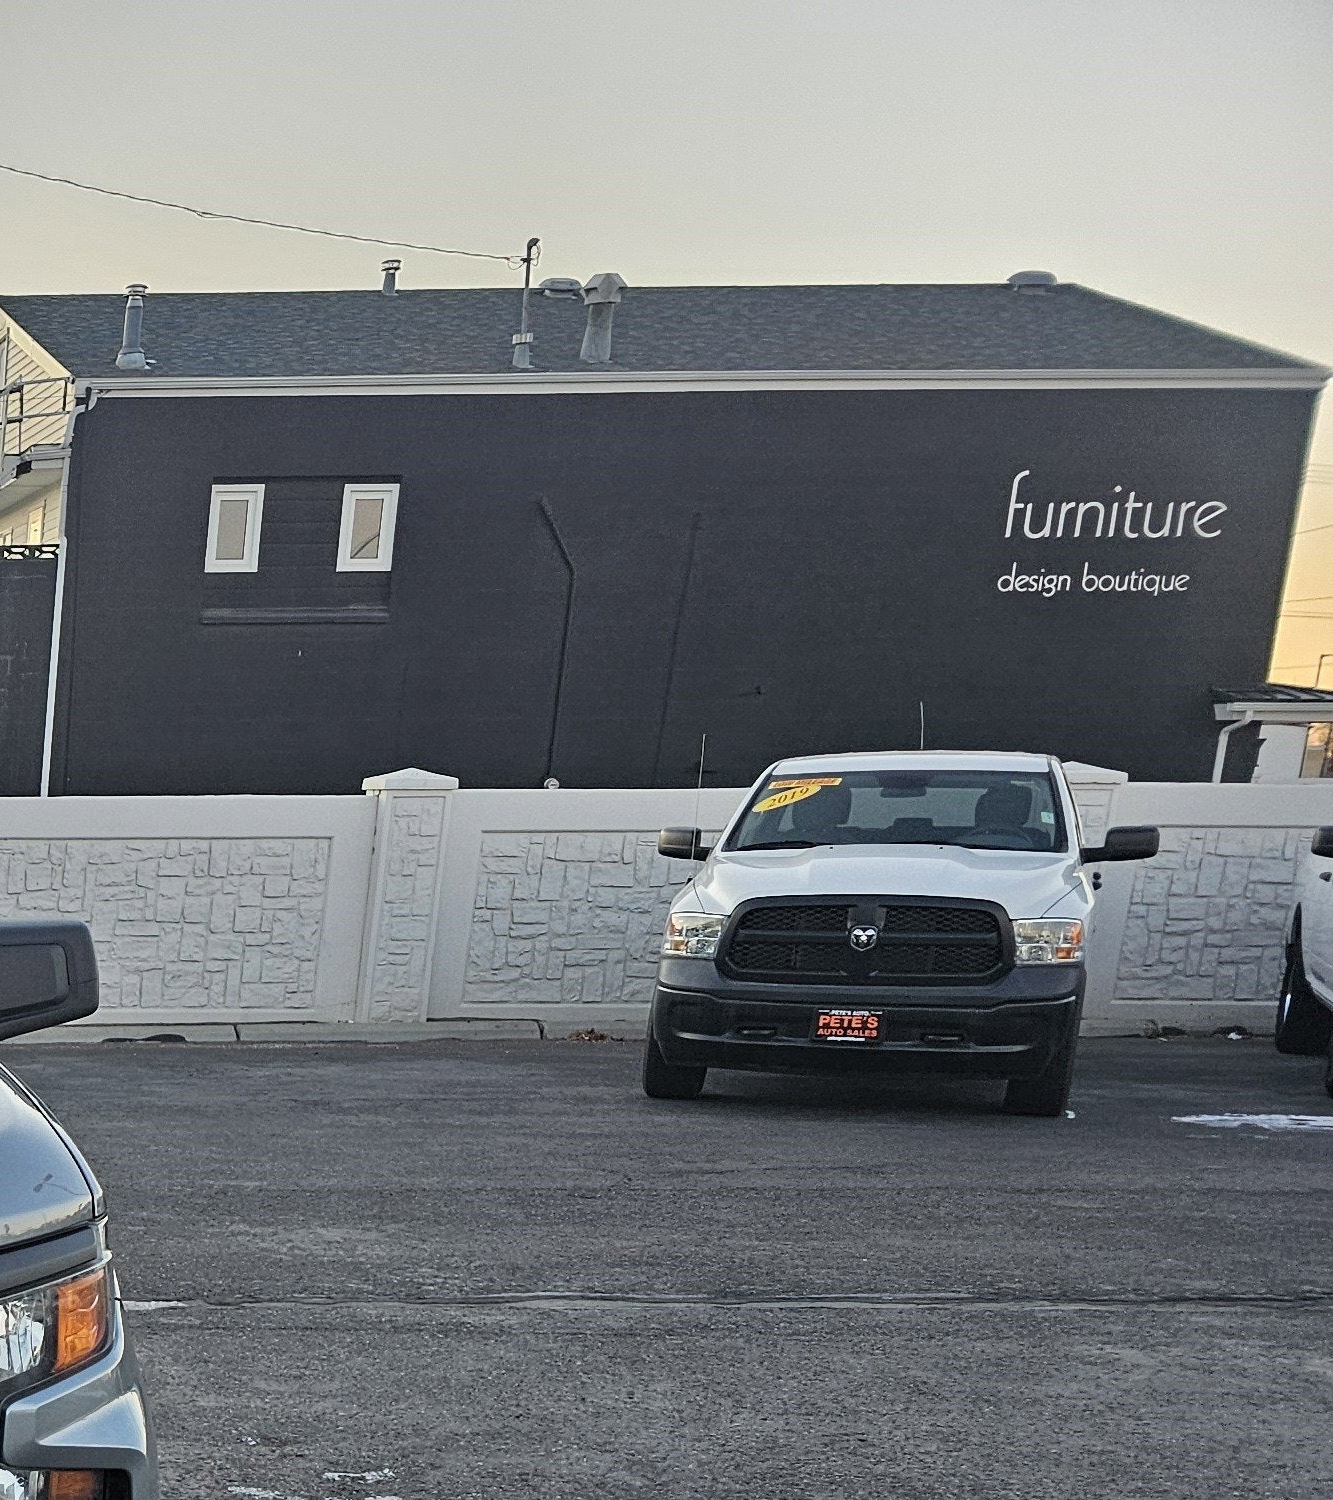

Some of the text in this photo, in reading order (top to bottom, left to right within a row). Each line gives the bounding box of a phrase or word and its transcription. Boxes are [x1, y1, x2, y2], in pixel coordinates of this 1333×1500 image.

[1004, 470, 1228, 538] furniture
[997, 562, 1190, 597] design boutique
[768, 787, 809, 807] 2019
[819, 1015, 878, 1028] PETE'S
